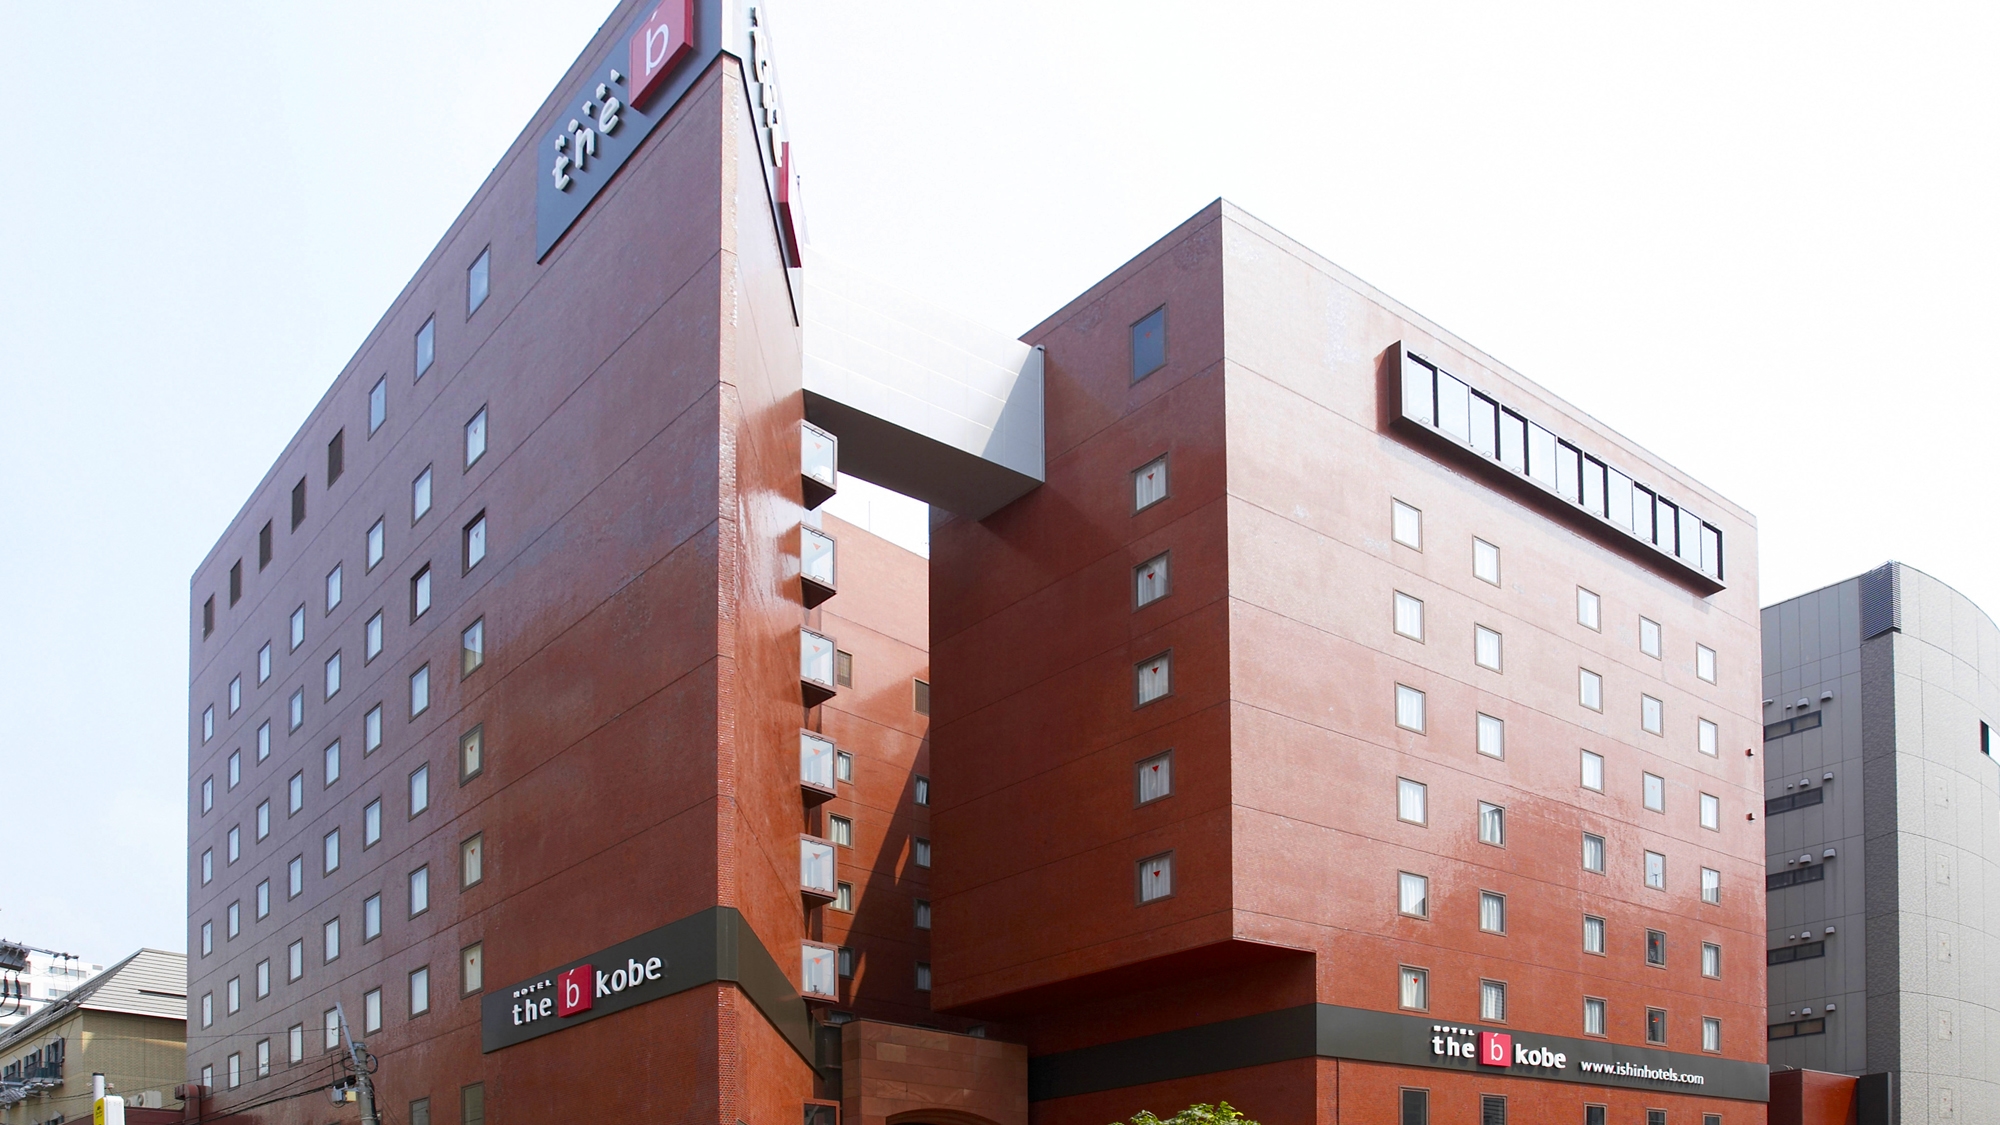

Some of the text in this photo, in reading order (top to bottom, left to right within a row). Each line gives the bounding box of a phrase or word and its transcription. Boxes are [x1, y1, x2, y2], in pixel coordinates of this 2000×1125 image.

[552, 96, 620, 191] the
[512, 997, 552, 1026] the
[596, 956, 662, 998] kobe
[513, 979, 552, 998] HOTEL
[1433, 1025, 1475, 1036] HOTEL
[1432, 1036, 1475, 1058] the
[1515, 1043, 1567, 1069] kobe
[1580, 1061, 1704, 1085] www.ishinhotels.com
